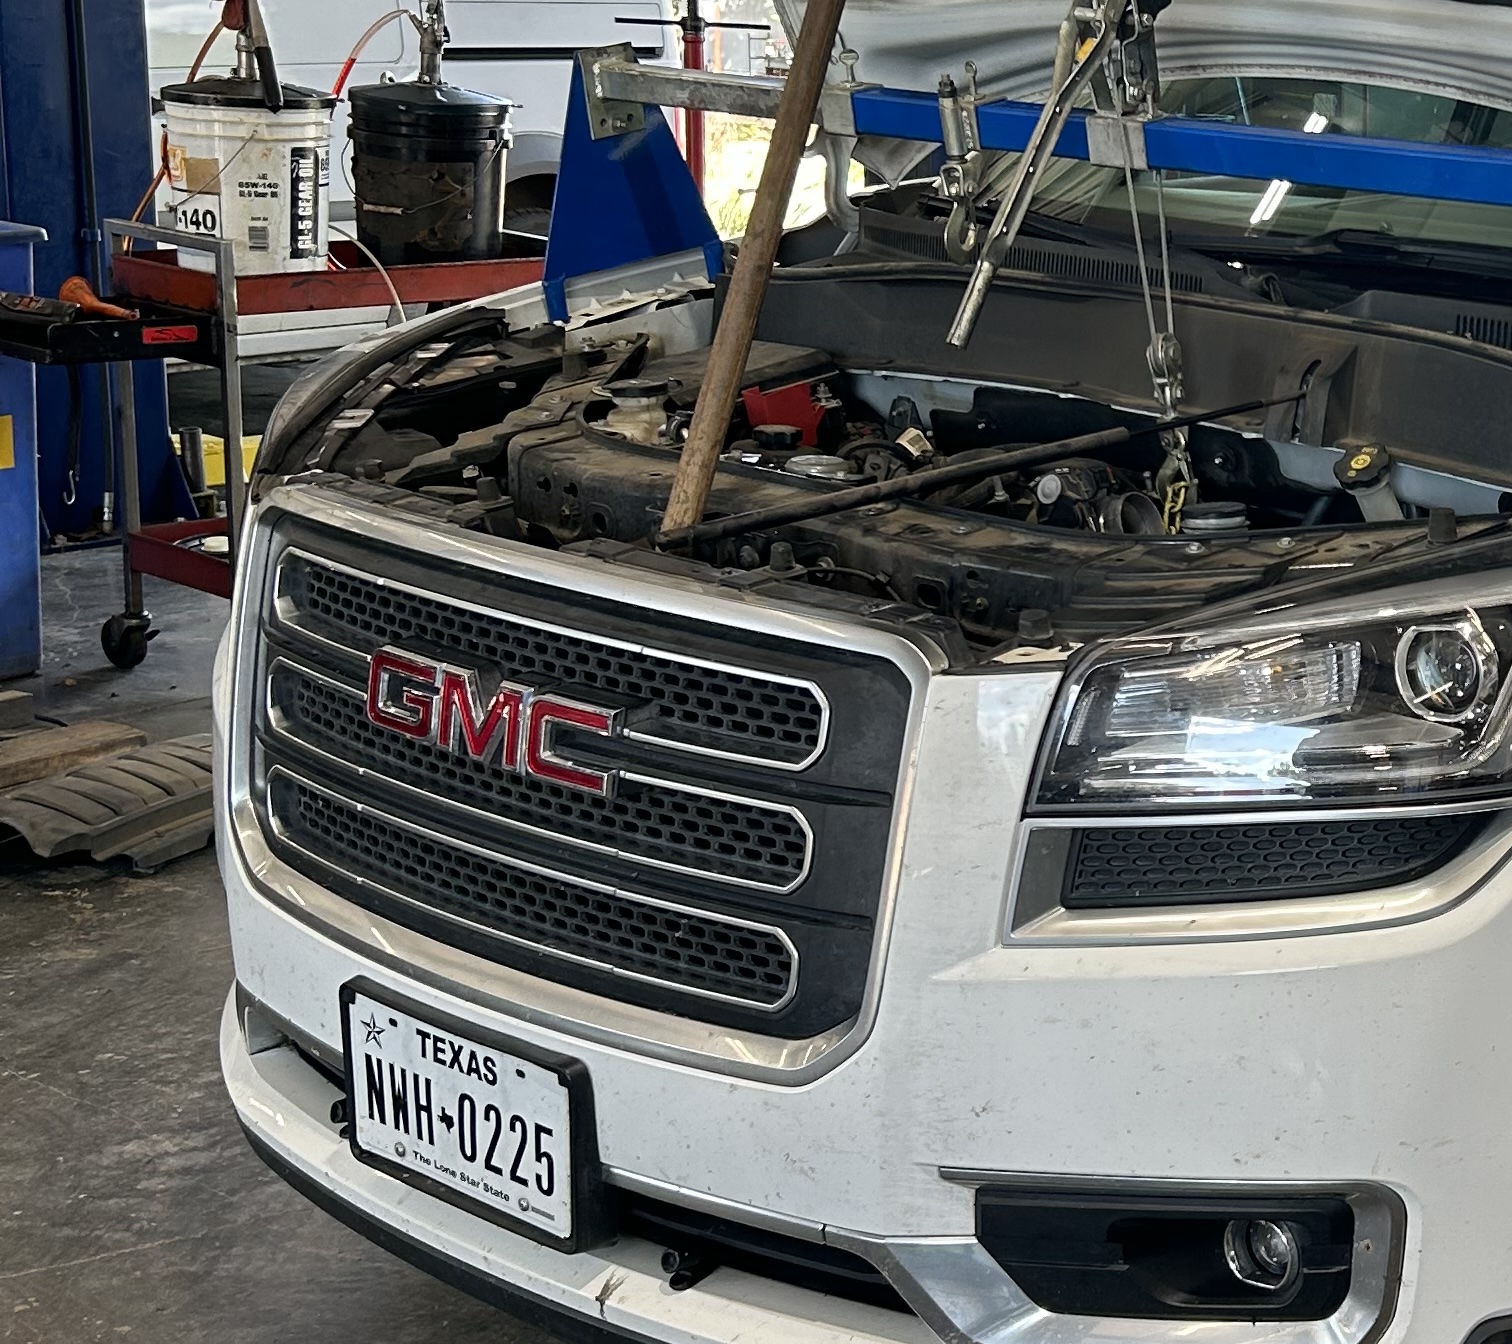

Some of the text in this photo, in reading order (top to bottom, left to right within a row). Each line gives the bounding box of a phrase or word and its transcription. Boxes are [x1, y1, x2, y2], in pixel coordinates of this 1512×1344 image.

[297, 155, 314, 249] GL-5 GEAR OIL
[367, 644, 623, 799] GMC
[415, 1028, 498, 1086] TEXAS
[412, 1150, 510, 1202] The Lone Star State
